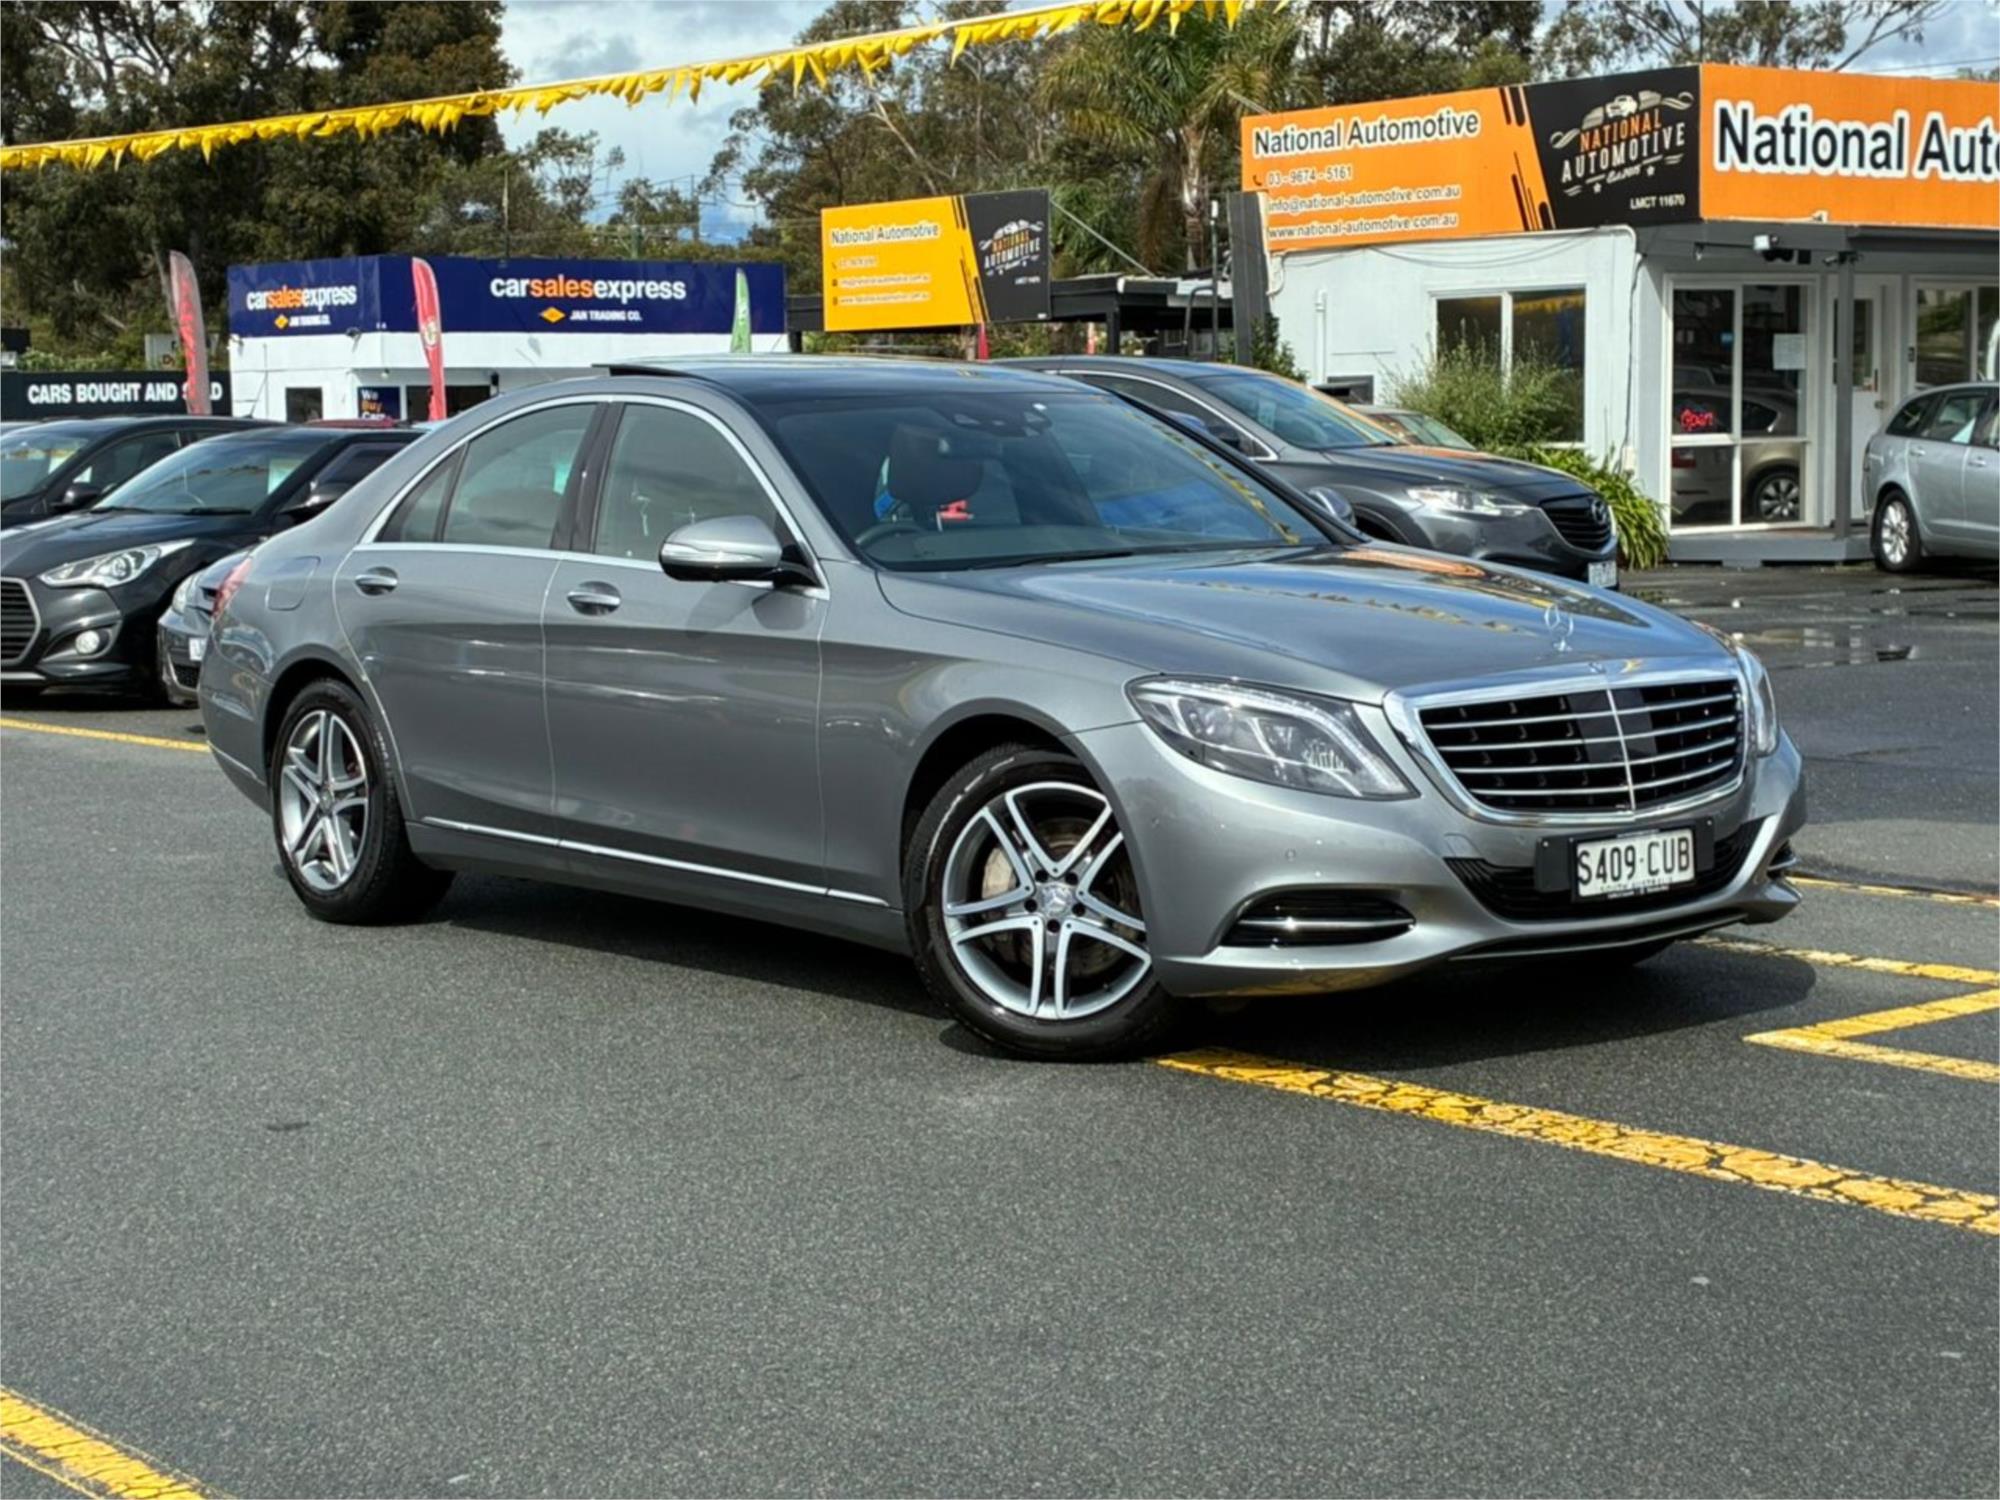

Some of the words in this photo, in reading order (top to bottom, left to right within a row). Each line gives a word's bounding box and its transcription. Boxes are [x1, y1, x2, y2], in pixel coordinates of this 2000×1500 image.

[1255, 123, 1341, 154] National
[1347, 109, 1478, 145] Automotive
[1580, 108, 1662, 153] NATIONAL
[1718, 107, 1905, 172] National
[1918, 117, 1999, 175] Aut
[1561, 122, 1686, 183] AUTOMOTIVE
[1630, 197, 1657, 210] LMCT
[831, 227, 875, 244] National
[876, 222, 939, 240] Automotive
[246, 284, 358, 312] carsalesexpress
[489, 274, 686, 304] carsalesexpress
[28, 384, 72, 404] CARS
[76, 382, 141, 403] BOUGHT
[145, 382, 178, 401] AND
